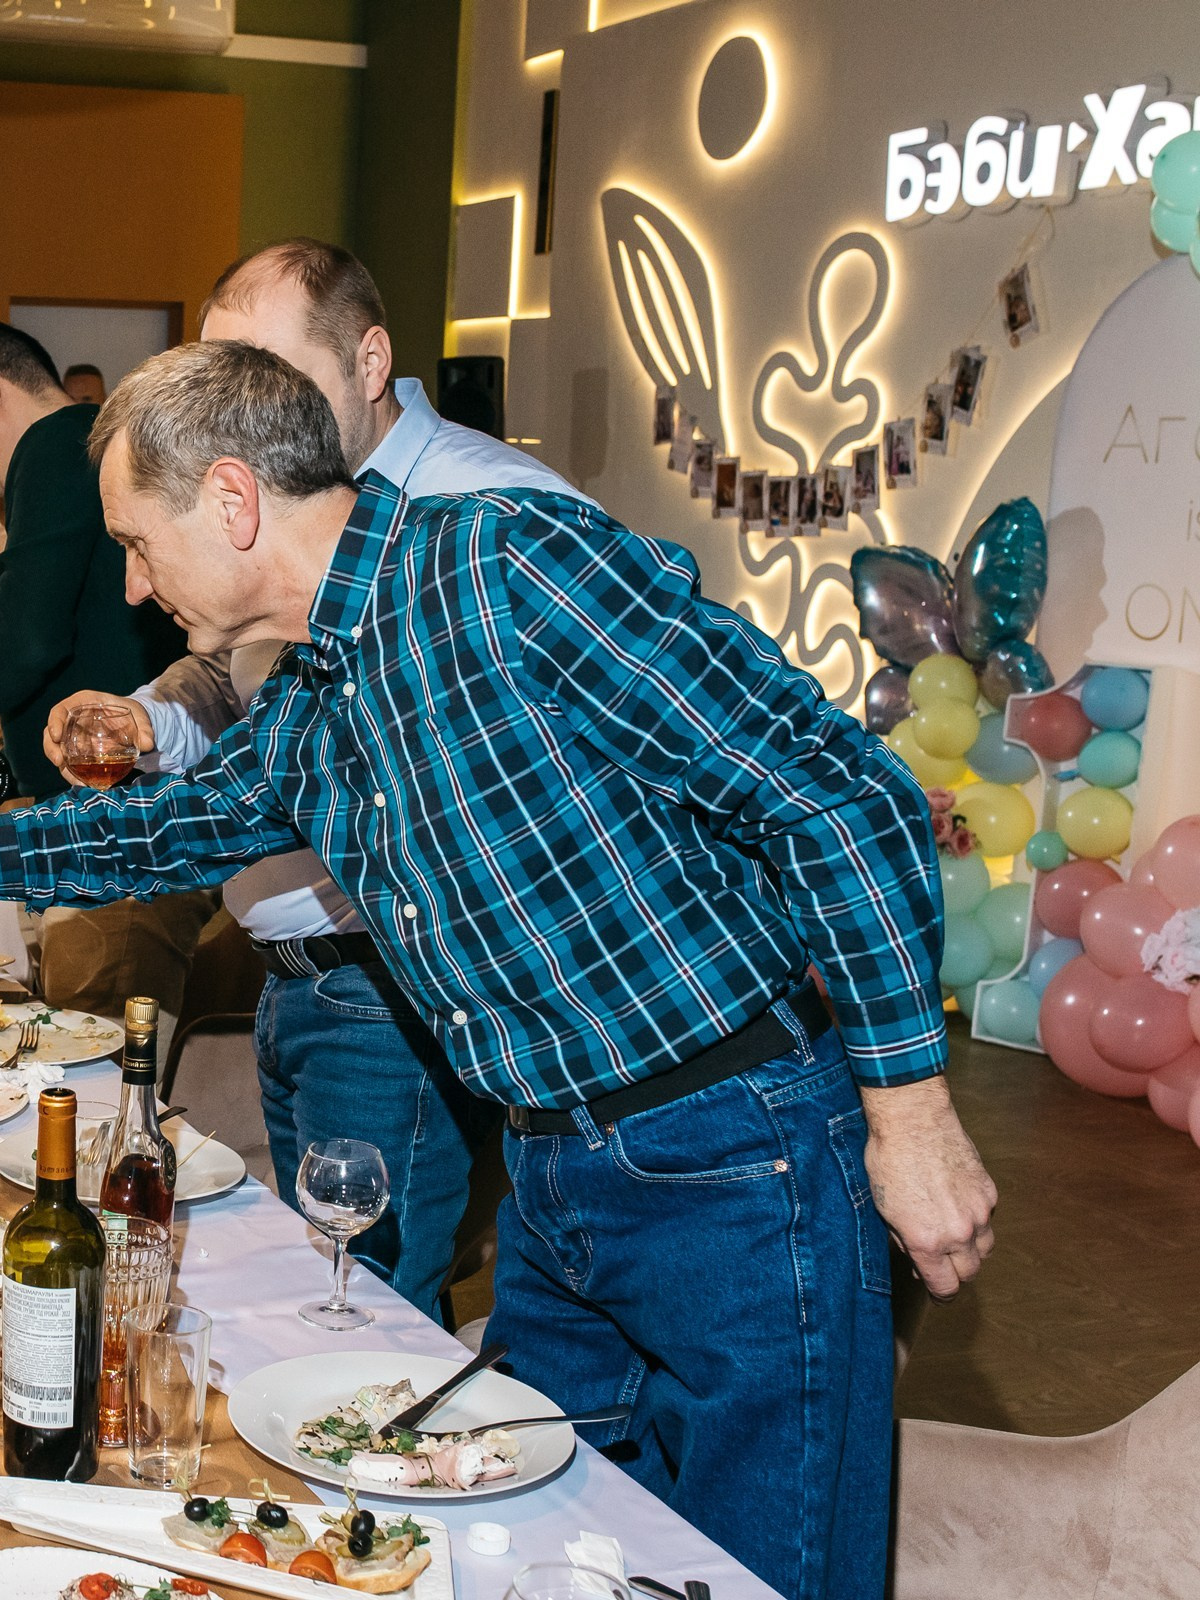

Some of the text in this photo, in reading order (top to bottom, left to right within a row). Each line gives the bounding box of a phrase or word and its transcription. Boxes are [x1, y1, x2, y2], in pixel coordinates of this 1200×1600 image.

[885, 83, 1200, 223] Бэби Ха
[1103, 403, 1200, 464] АГ
